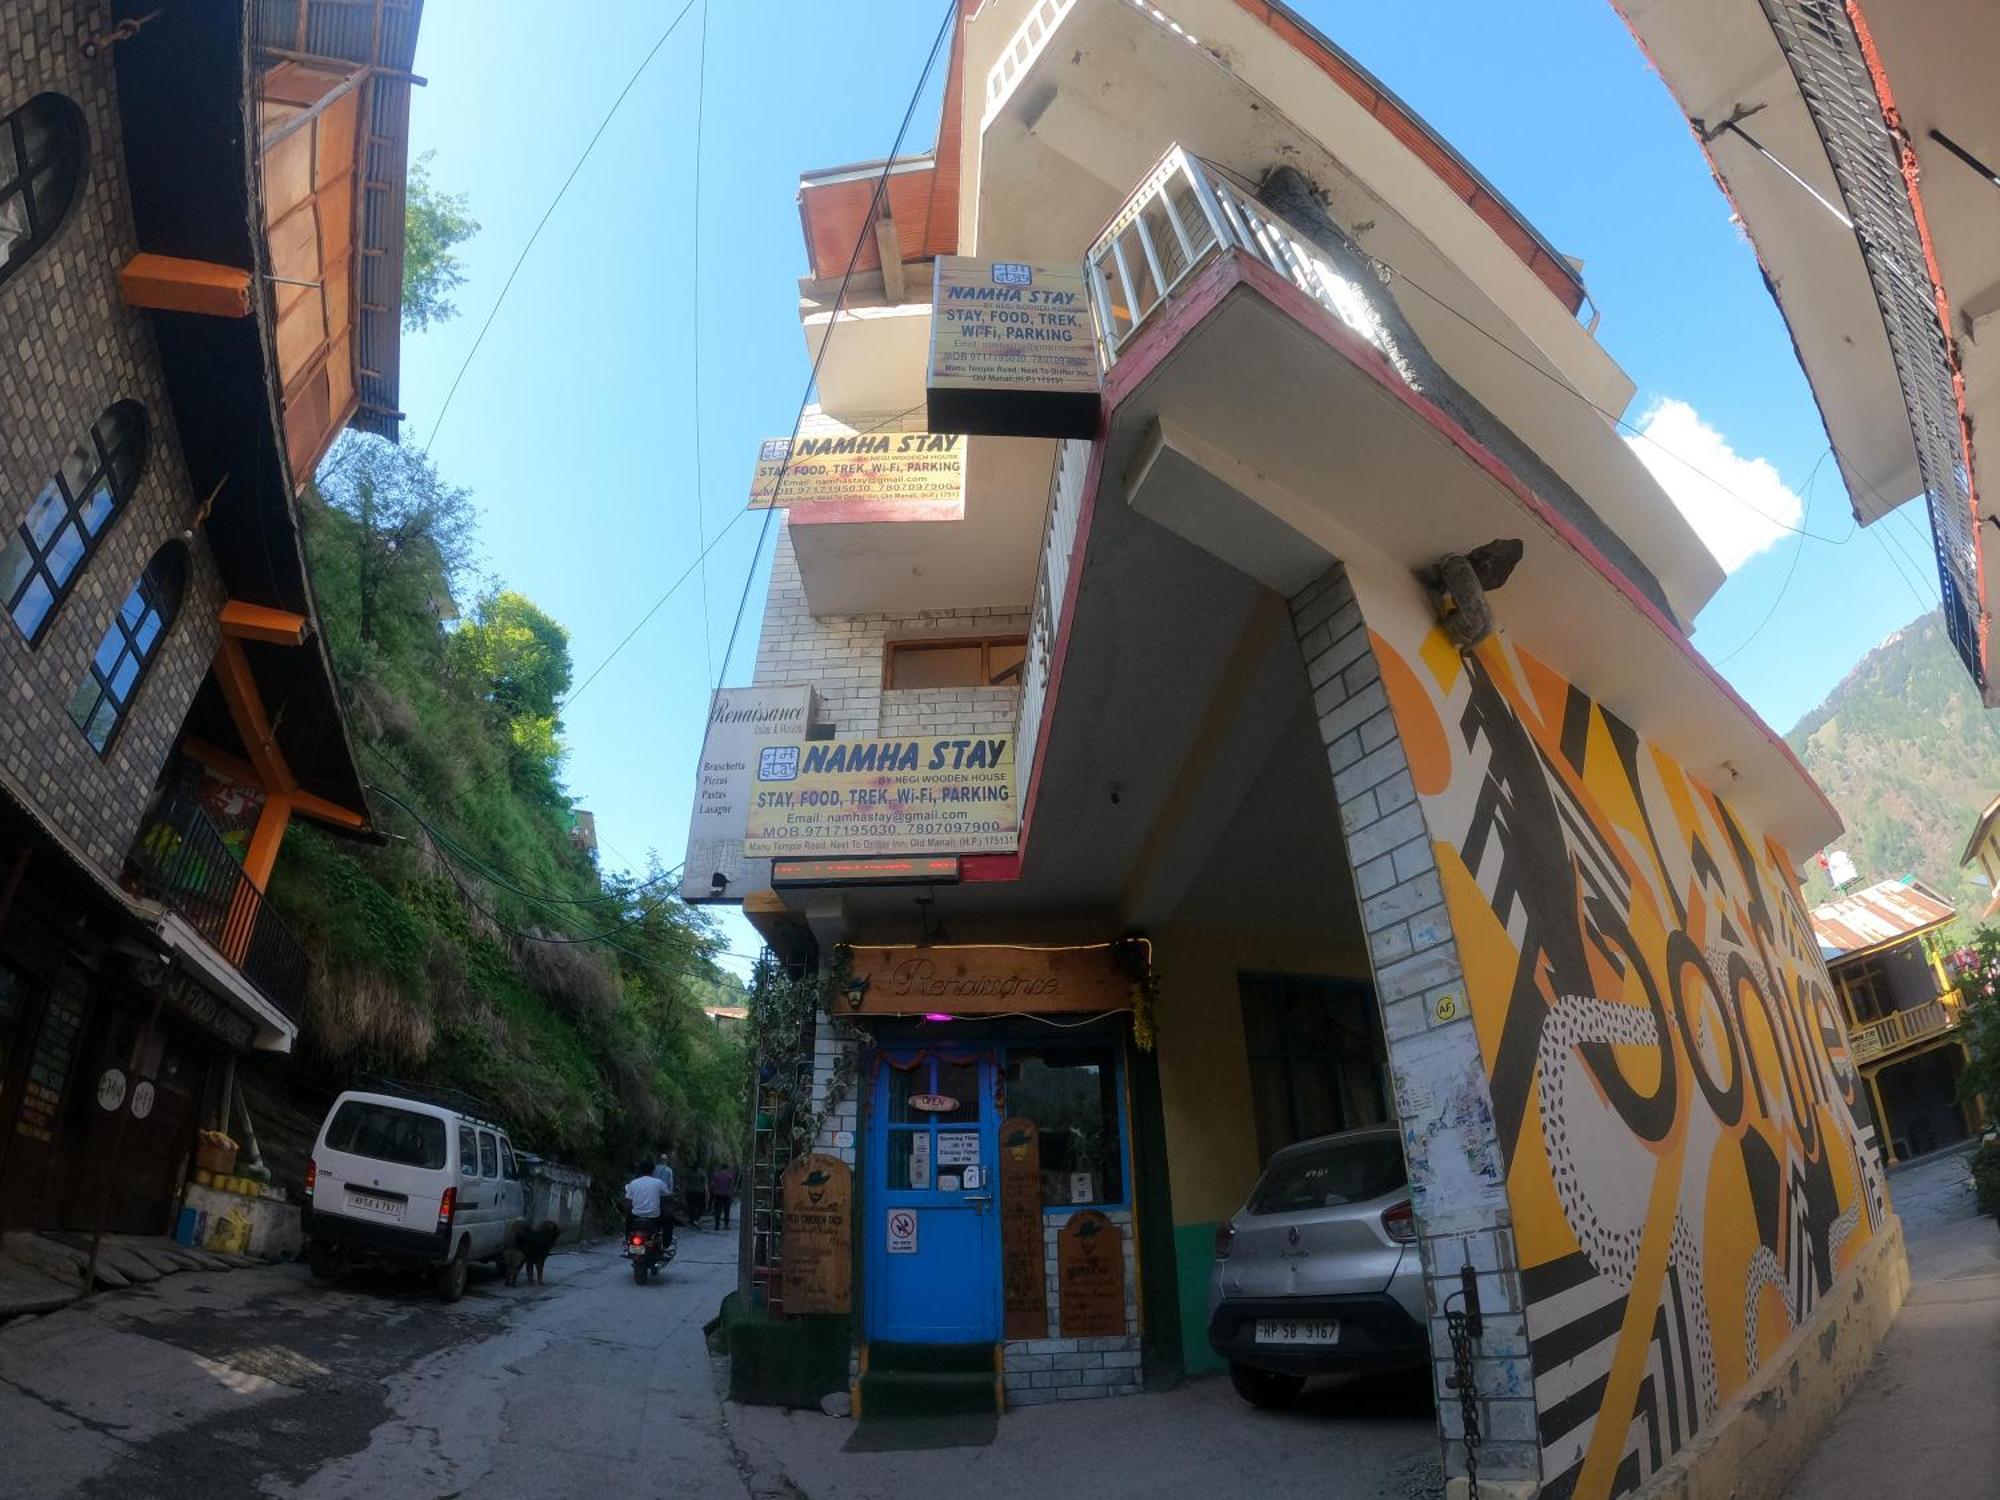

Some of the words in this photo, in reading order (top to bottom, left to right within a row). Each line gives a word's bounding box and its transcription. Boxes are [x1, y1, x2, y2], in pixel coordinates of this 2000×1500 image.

[948, 286, 1021, 302] NAMHA
[1029, 290, 1076, 305] STAY
[990, 311, 1034, 325] FOOD,
[1038, 313, 1082, 328] TREK,
[1006, 326, 1073, 341] PARKING
[797, 436, 890, 456] NAMHA
[897, 434, 960, 452] STAY
[907, 461, 960, 472] PARKING
[711, 698, 805, 724] Renaissance
[802, 742, 919, 773] NAMHA
[928, 739, 1006, 769] STAY
[895, 775, 919, 784] NEGI
[922, 774, 969, 784] WOODEN
[971, 772, 1007, 782] HOUSE
[758, 791, 795, 809] STAY,
[800, 790, 843, 808] FOOD,
[848, 788, 892, 806] TREK,
[897, 786, 937, 806] Wi-Fi,
[942, 784, 1009, 803] PARKING
[827, 809, 967, 823] namhastay@gmail.com
[907, 822, 1000, 835] 7807097900
[1264, 1324, 1277, 1338] HP
